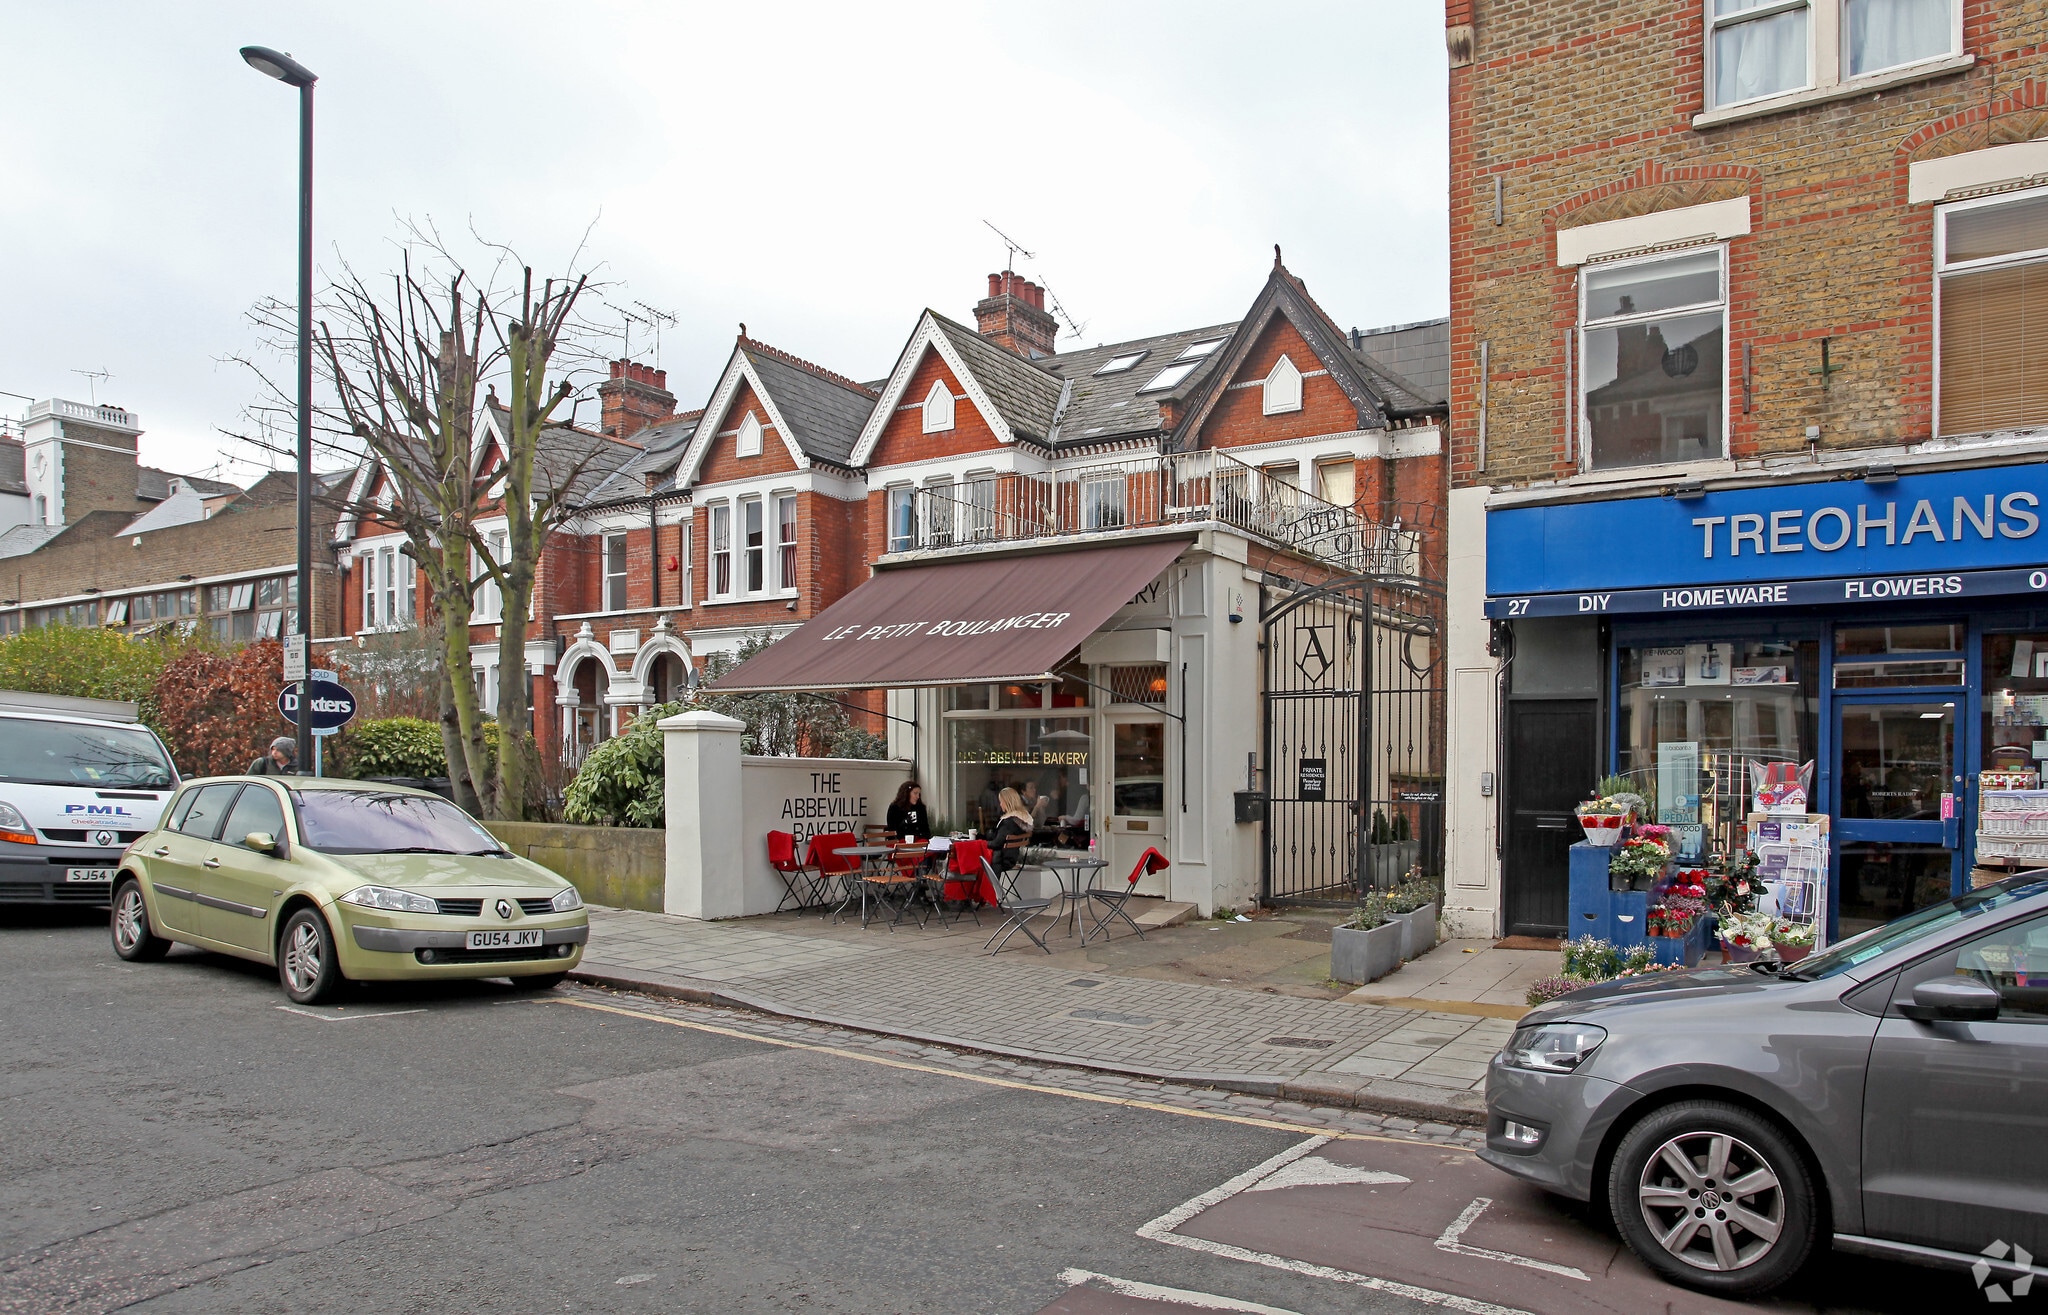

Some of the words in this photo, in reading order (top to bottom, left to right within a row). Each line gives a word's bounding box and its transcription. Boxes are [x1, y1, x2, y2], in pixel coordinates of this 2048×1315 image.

[1692, 491, 2038, 558] TREOHANS
[1311, 530, 1421, 555] COURT
[1508, 599, 1531, 616] 27
[1578, 594, 1612, 612] DIY
[1662, 585, 1788, 608] HOMEWARE
[1845, 576, 1962, 599] FLOWERS
[822, 625, 861, 641] LE
[856, 621, 929, 641] PETIT
[926, 612, 1071, 637] BOULANGER
[1643, 649, 1684, 657] KENWOOD
[982, 751, 1039, 764] ABBEVILLE
[1043, 752, 1088, 765] BAKERY
[810, 773, 841, 794] THE
[65, 804, 132, 816] PML
[781, 797, 868, 820] ABBEVILLE
[1664, 813, 1696, 823] PEDAL
[793, 820, 858, 843] BAKERY
[73, 870, 107, 881] SJ54
[473, 932, 510, 947] GU54
[513, 931, 539, 945] JKV
